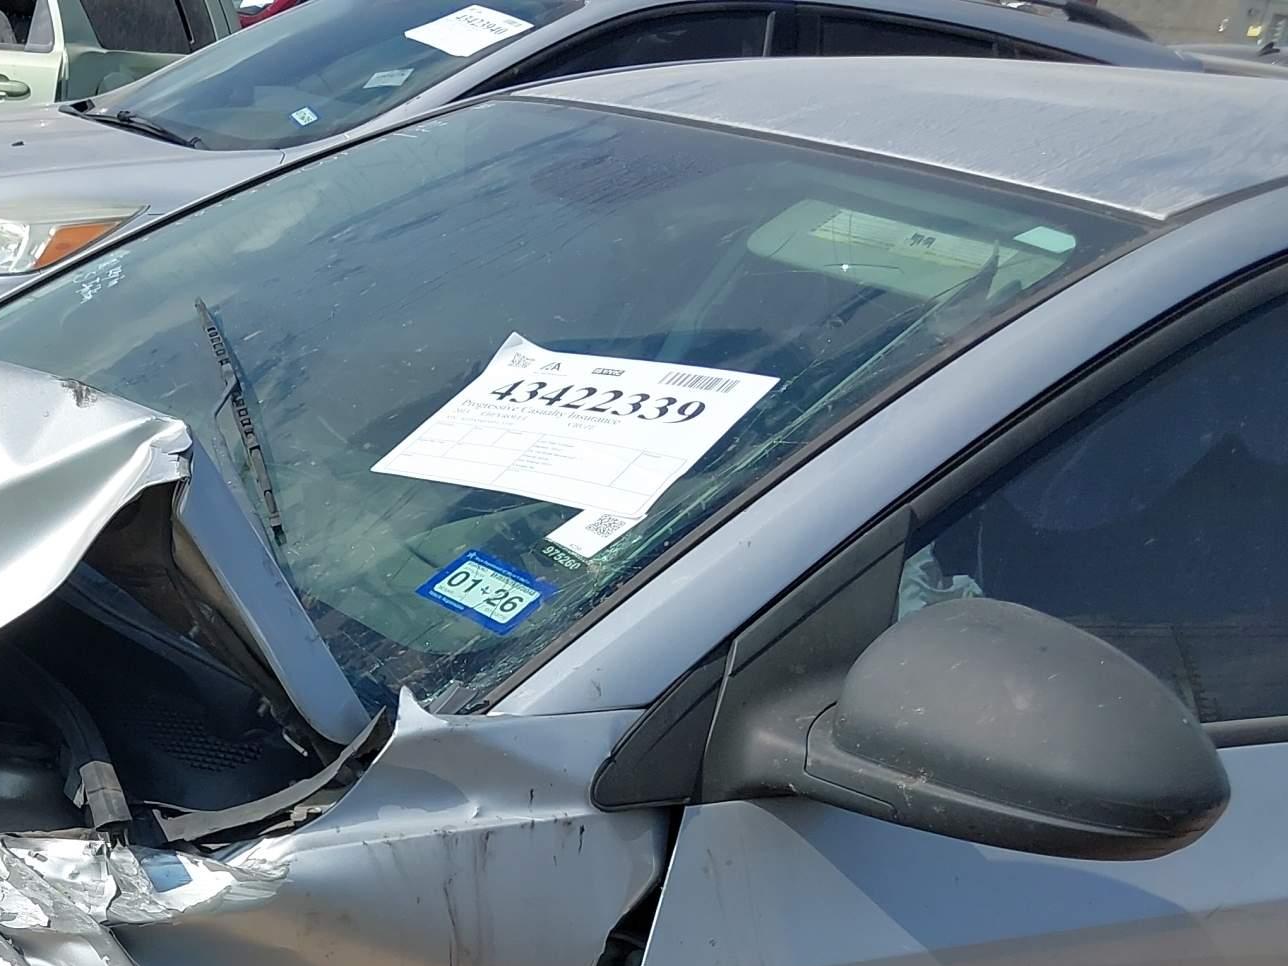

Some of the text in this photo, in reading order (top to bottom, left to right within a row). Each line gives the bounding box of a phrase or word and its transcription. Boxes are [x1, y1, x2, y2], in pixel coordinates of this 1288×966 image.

[461, 398, 518, 414] Progressive
[568, 412, 622, 425] Insurance
[489, 379, 707, 424] 43422339
[541, 545, 582, 570] 975260
